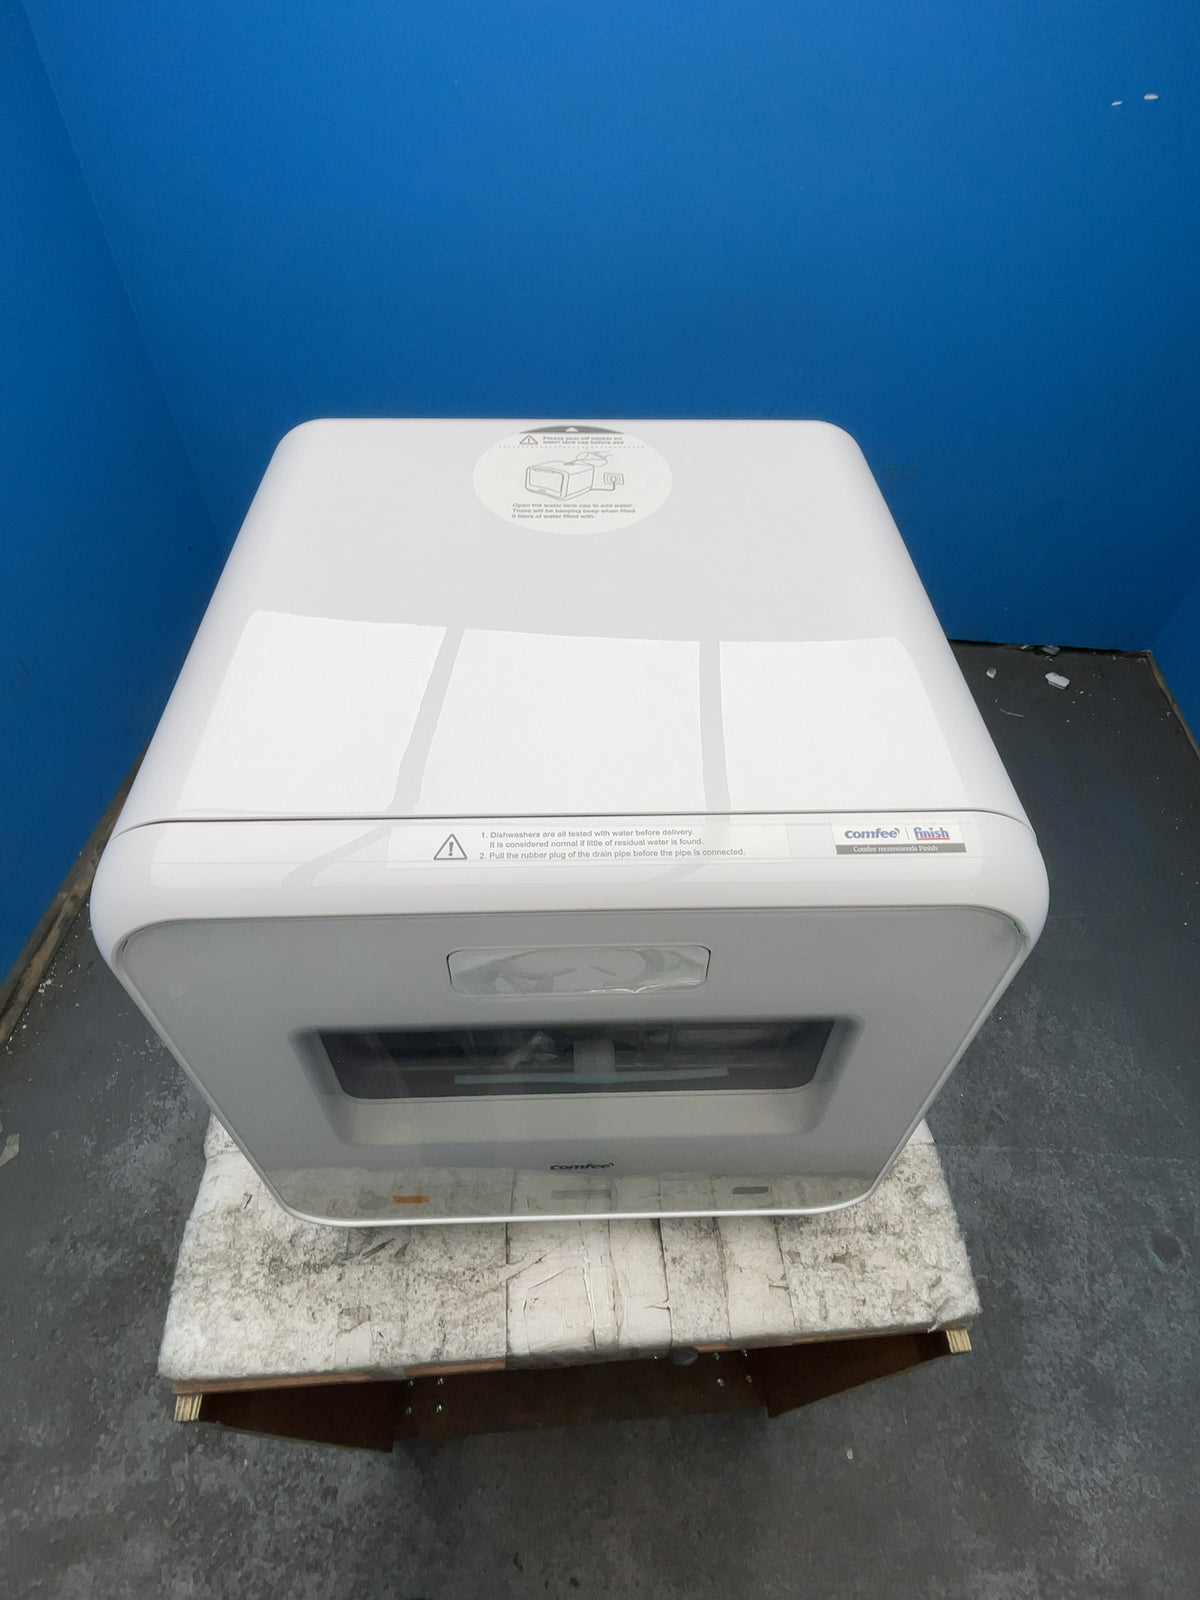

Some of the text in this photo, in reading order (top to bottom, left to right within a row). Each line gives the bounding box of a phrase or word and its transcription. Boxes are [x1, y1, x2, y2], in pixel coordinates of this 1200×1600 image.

[662, 829, 694, 837] delivery.
[844, 827, 950, 838] comfee finish
[550, 852, 566, 860] plug
[614, 850, 630, 859] pipe
[675, 850, 691, 858] pipe
